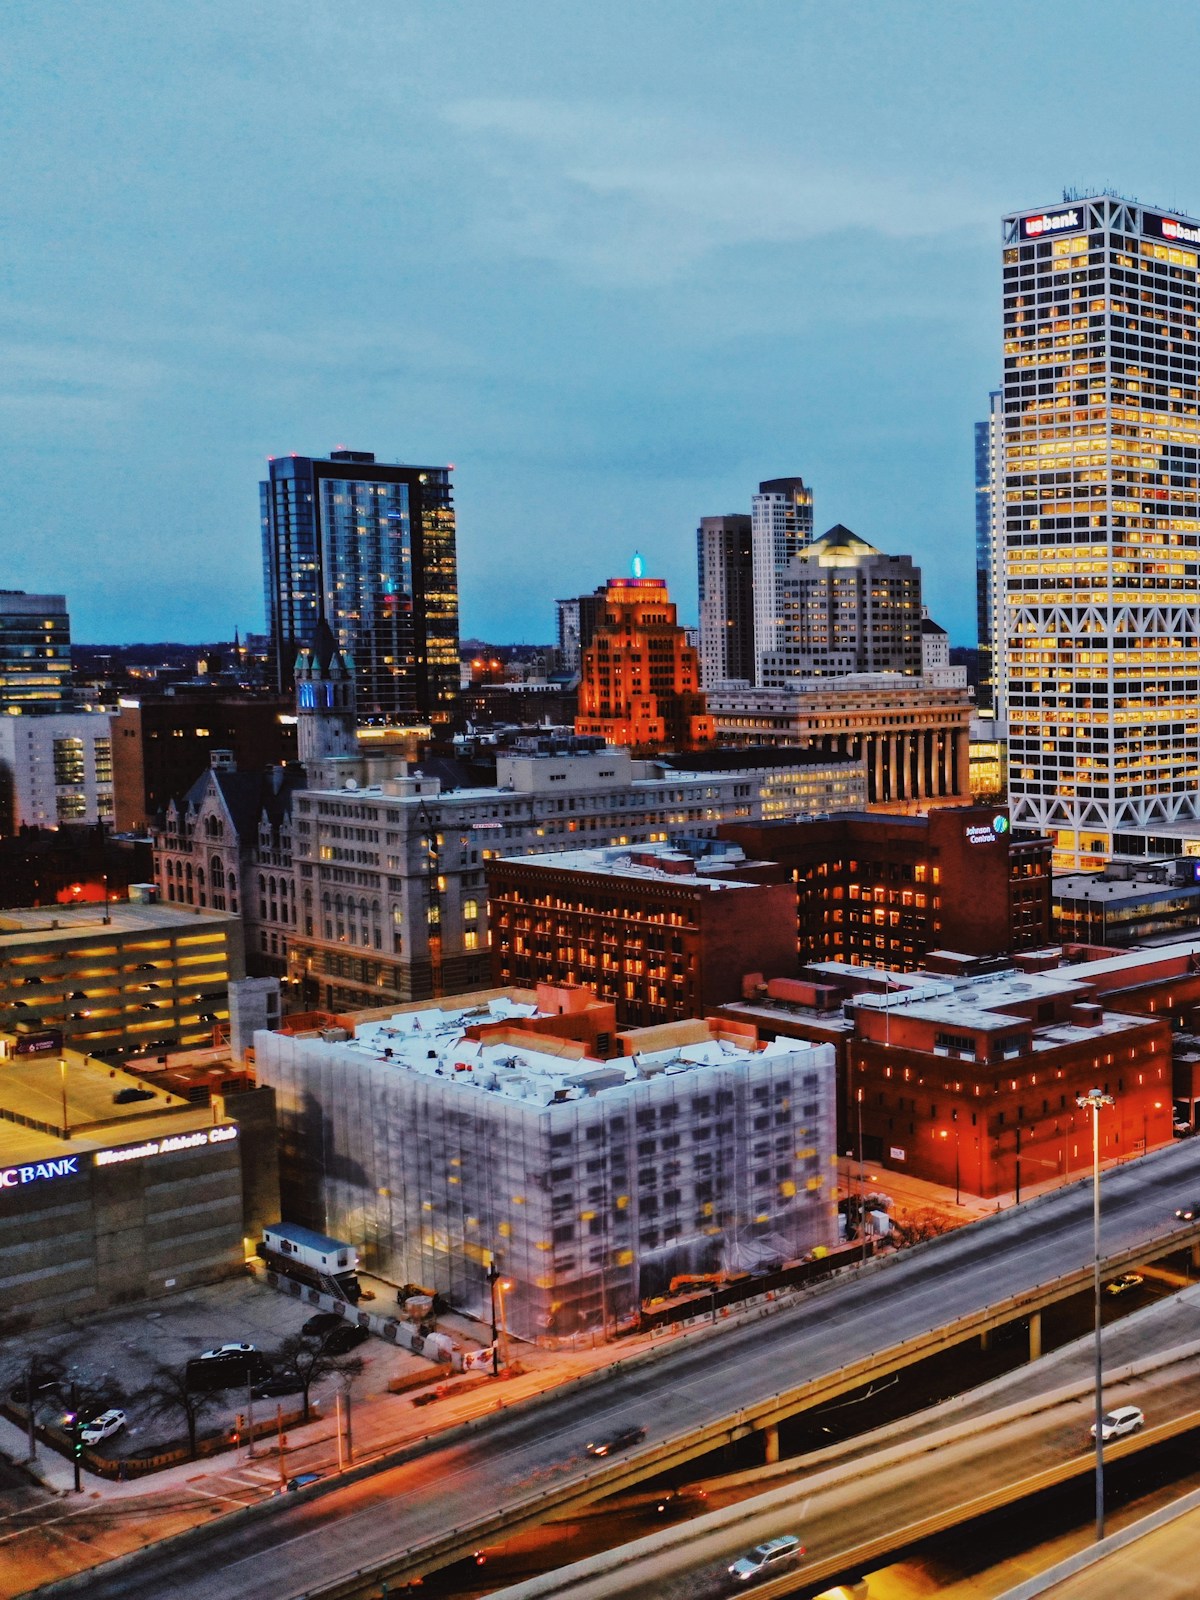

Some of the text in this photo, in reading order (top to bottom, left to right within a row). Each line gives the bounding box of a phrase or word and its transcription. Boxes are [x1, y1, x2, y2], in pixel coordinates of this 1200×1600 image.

[966, 826, 991, 836] Johnson
[970, 833, 995, 844] Controls
[160, 1133, 208, 1153] Athletic
[209, 1126, 238, 1143] Club
